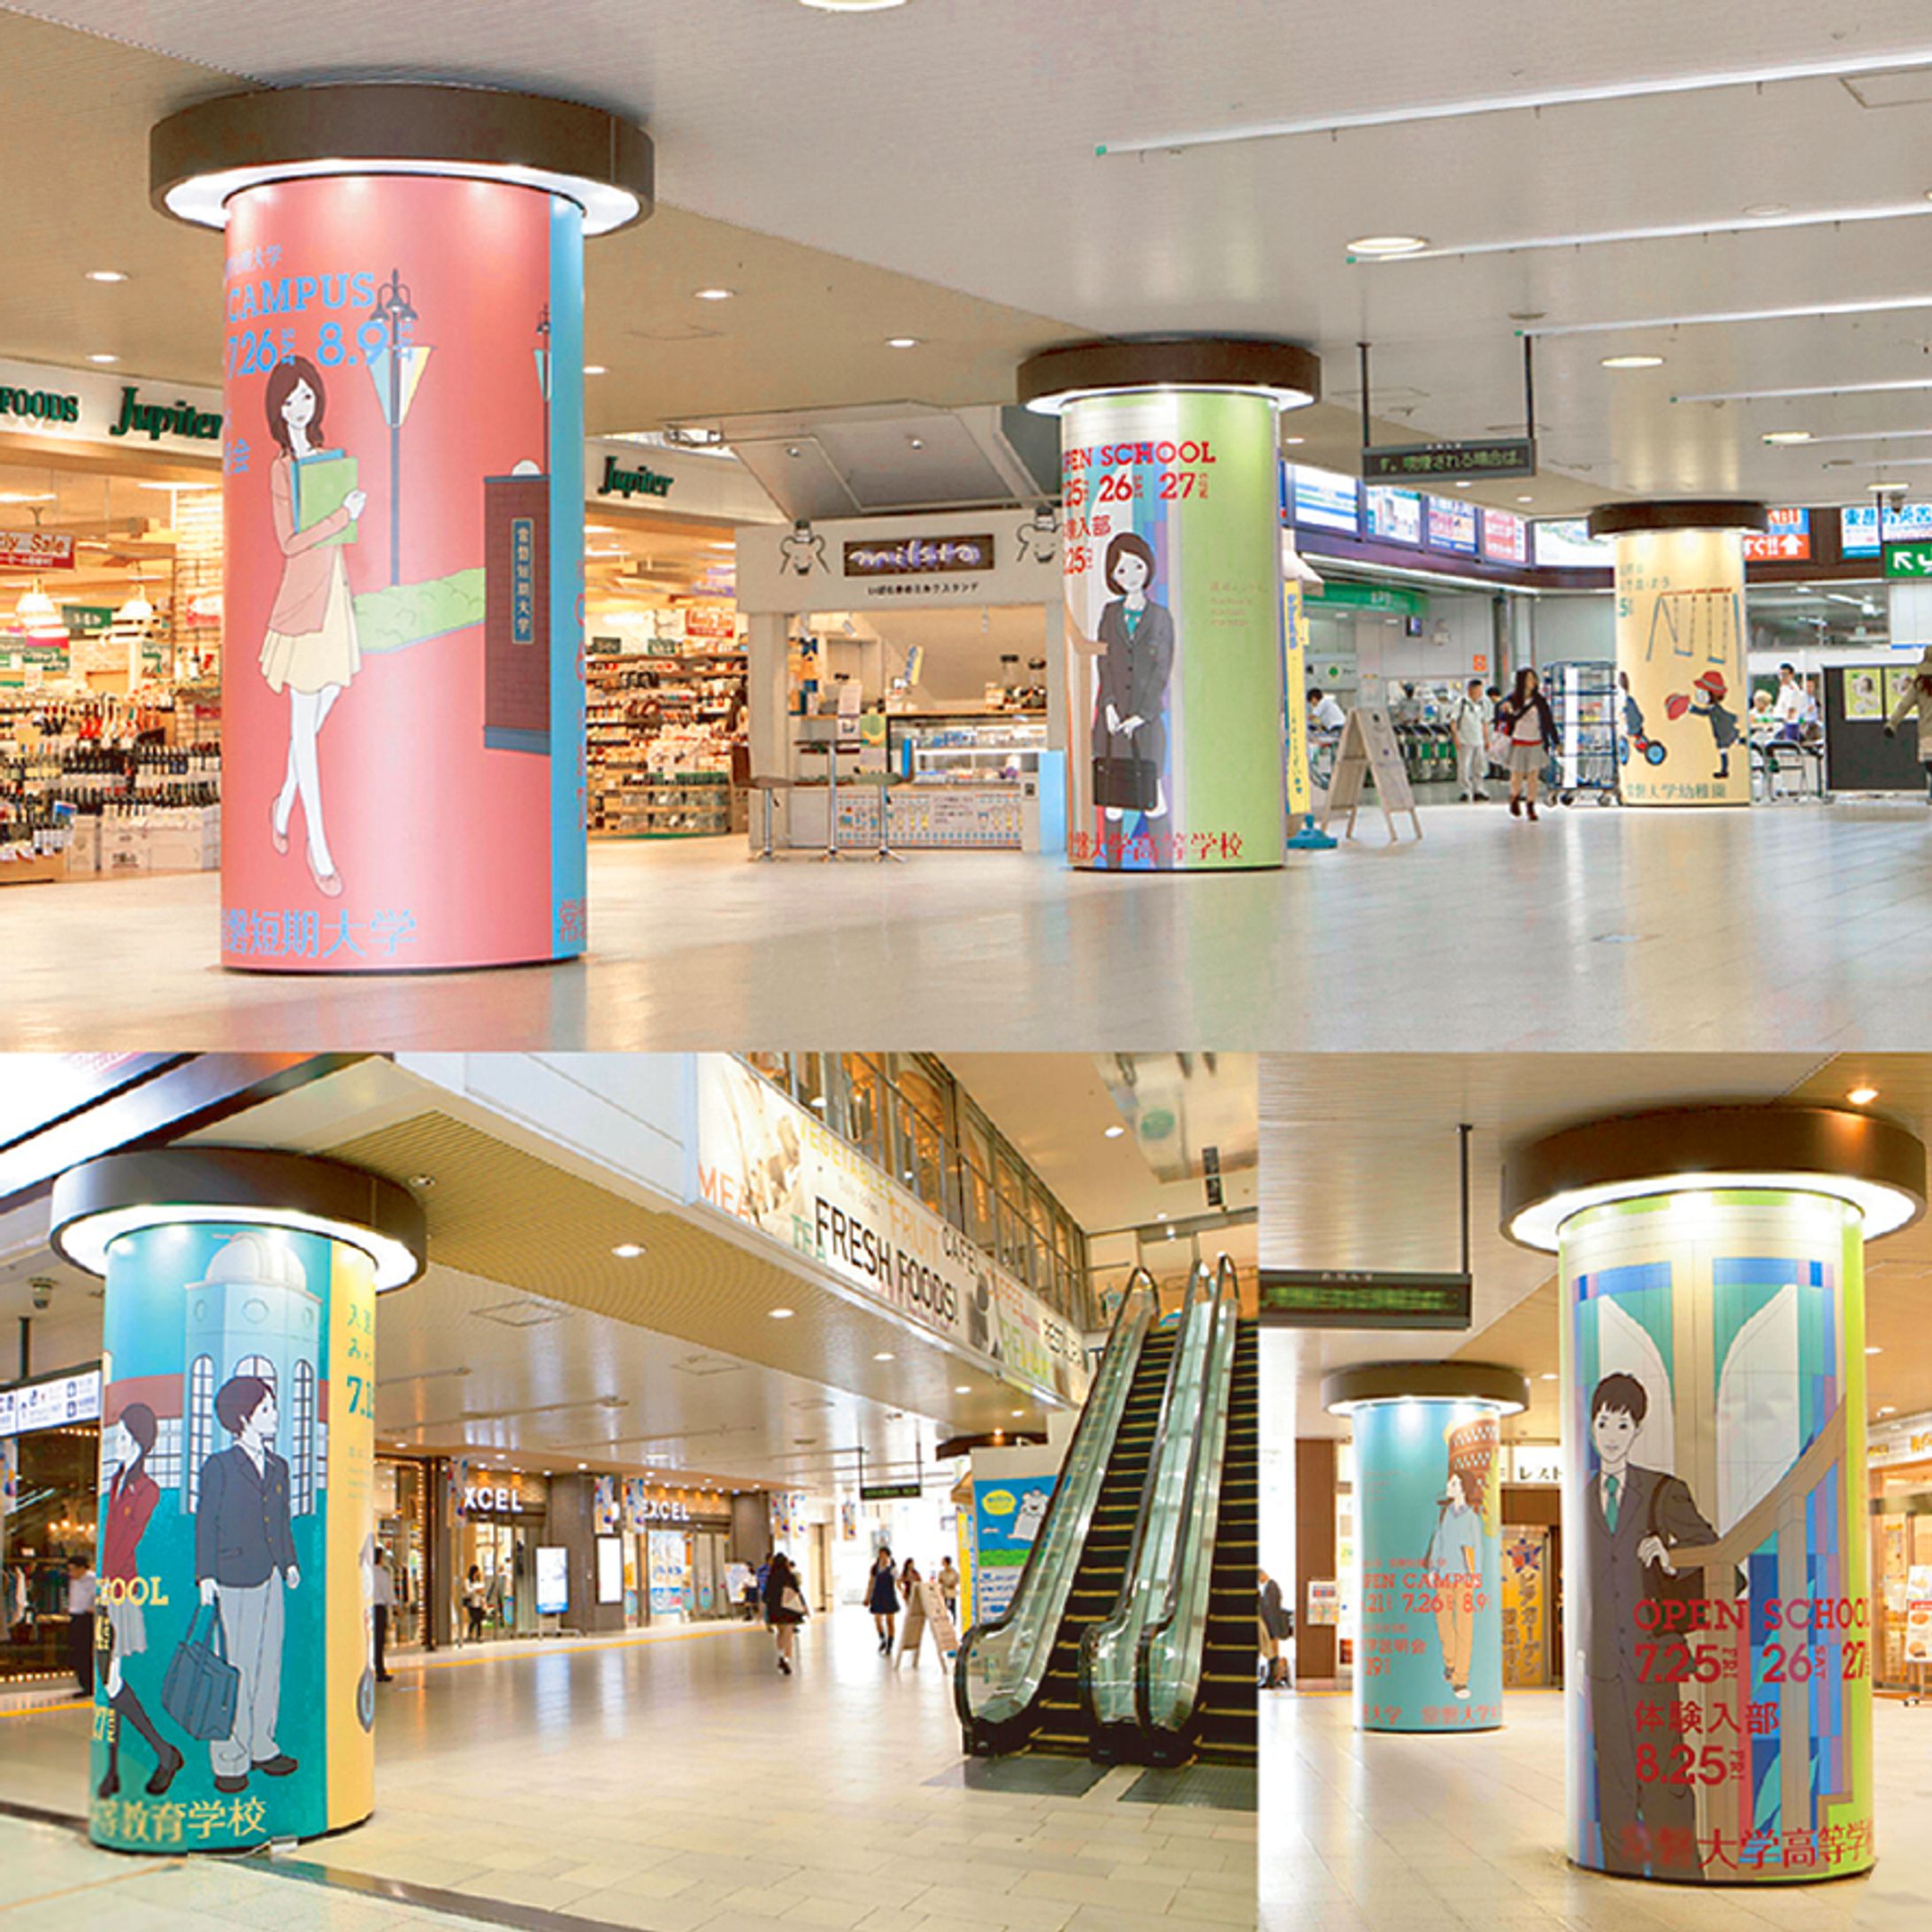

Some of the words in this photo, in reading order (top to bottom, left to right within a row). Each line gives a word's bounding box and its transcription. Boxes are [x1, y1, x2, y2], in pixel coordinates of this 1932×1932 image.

[228, 272, 375, 323] CAMPUS
[316, 321, 390, 367] 8.9
[0, 387, 79, 423] FOODS
[109, 386, 224, 441] Jupiter
[1100, 441, 1216, 467] SCHOOL
[597, 456, 674, 499] Jupiter
[1099, 473, 1133, 502] 26
[1159, 472, 1196, 499] 27
[223, 908, 417, 959] 磐短期大学
[816, 1195, 893, 1288] FRESH
[1401, 1572, 1484, 1590] CAMPUS
[1401, 1592, 1445, 1614] 7.26
[1632, 1598, 1748, 1631] OPEN
[1763, 1598, 1870, 1630] SCHOO
[1634, 1642, 1722, 1684] 7.25
[1761, 1642, 1813, 1684] 26
[1842, 1640, 1866, 1681] 27
[1633, 1699, 1780, 1735] 体験入部
[1634, 1742, 1729, 1786] 8.25
